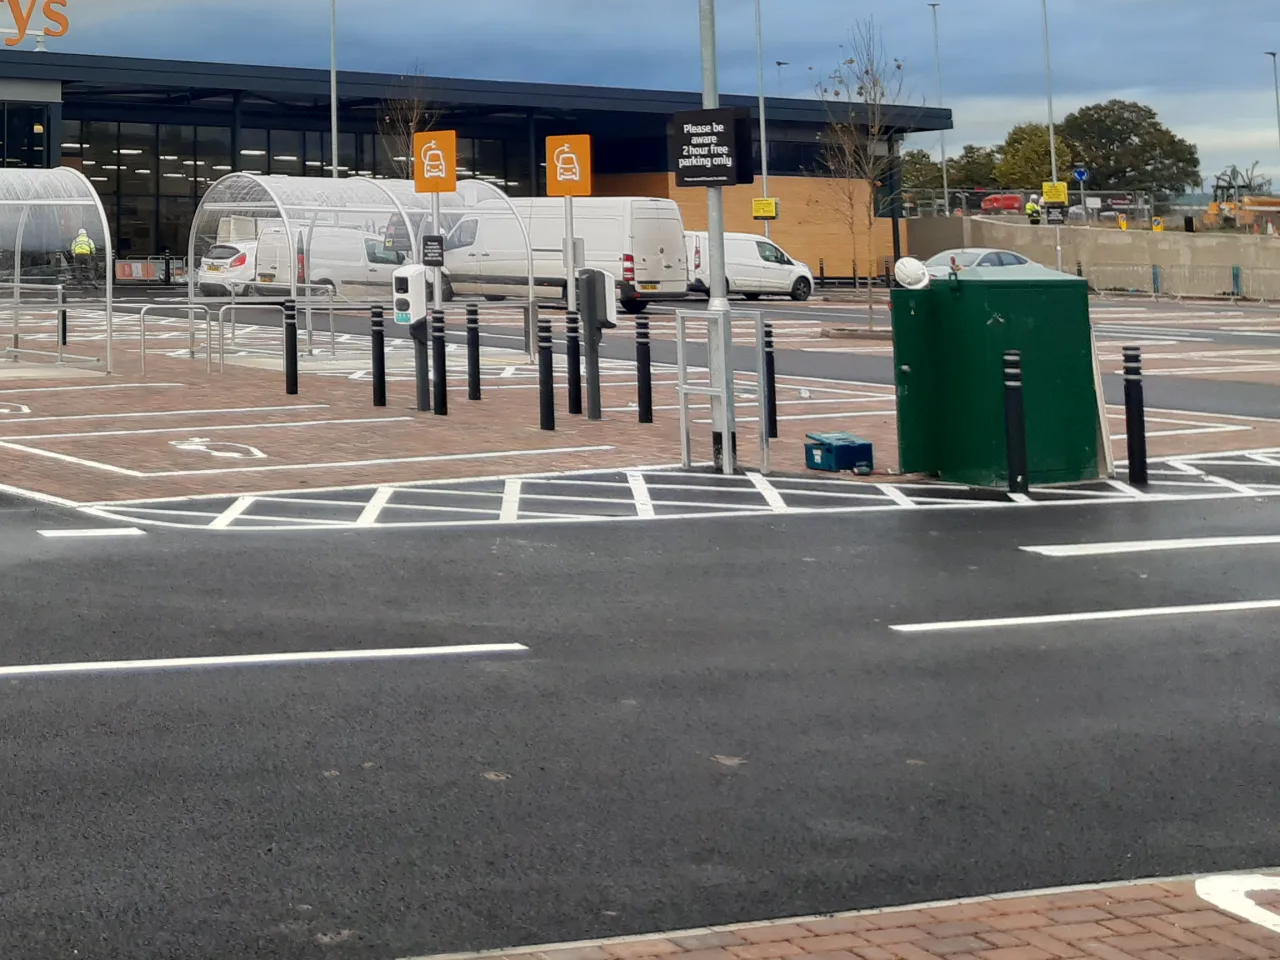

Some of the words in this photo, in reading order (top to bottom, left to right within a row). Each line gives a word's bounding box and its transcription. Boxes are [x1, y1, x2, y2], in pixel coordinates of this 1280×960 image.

[683, 123, 712, 134] Please
[712, 122, 725, 132] be
[690, 135, 717, 144] aware
[682, 145, 689, 155] 2
[689, 145, 709, 155] hour
[710, 144, 728, 154] free
[678, 156, 711, 168] parking
[712, 155, 732, 167] only
